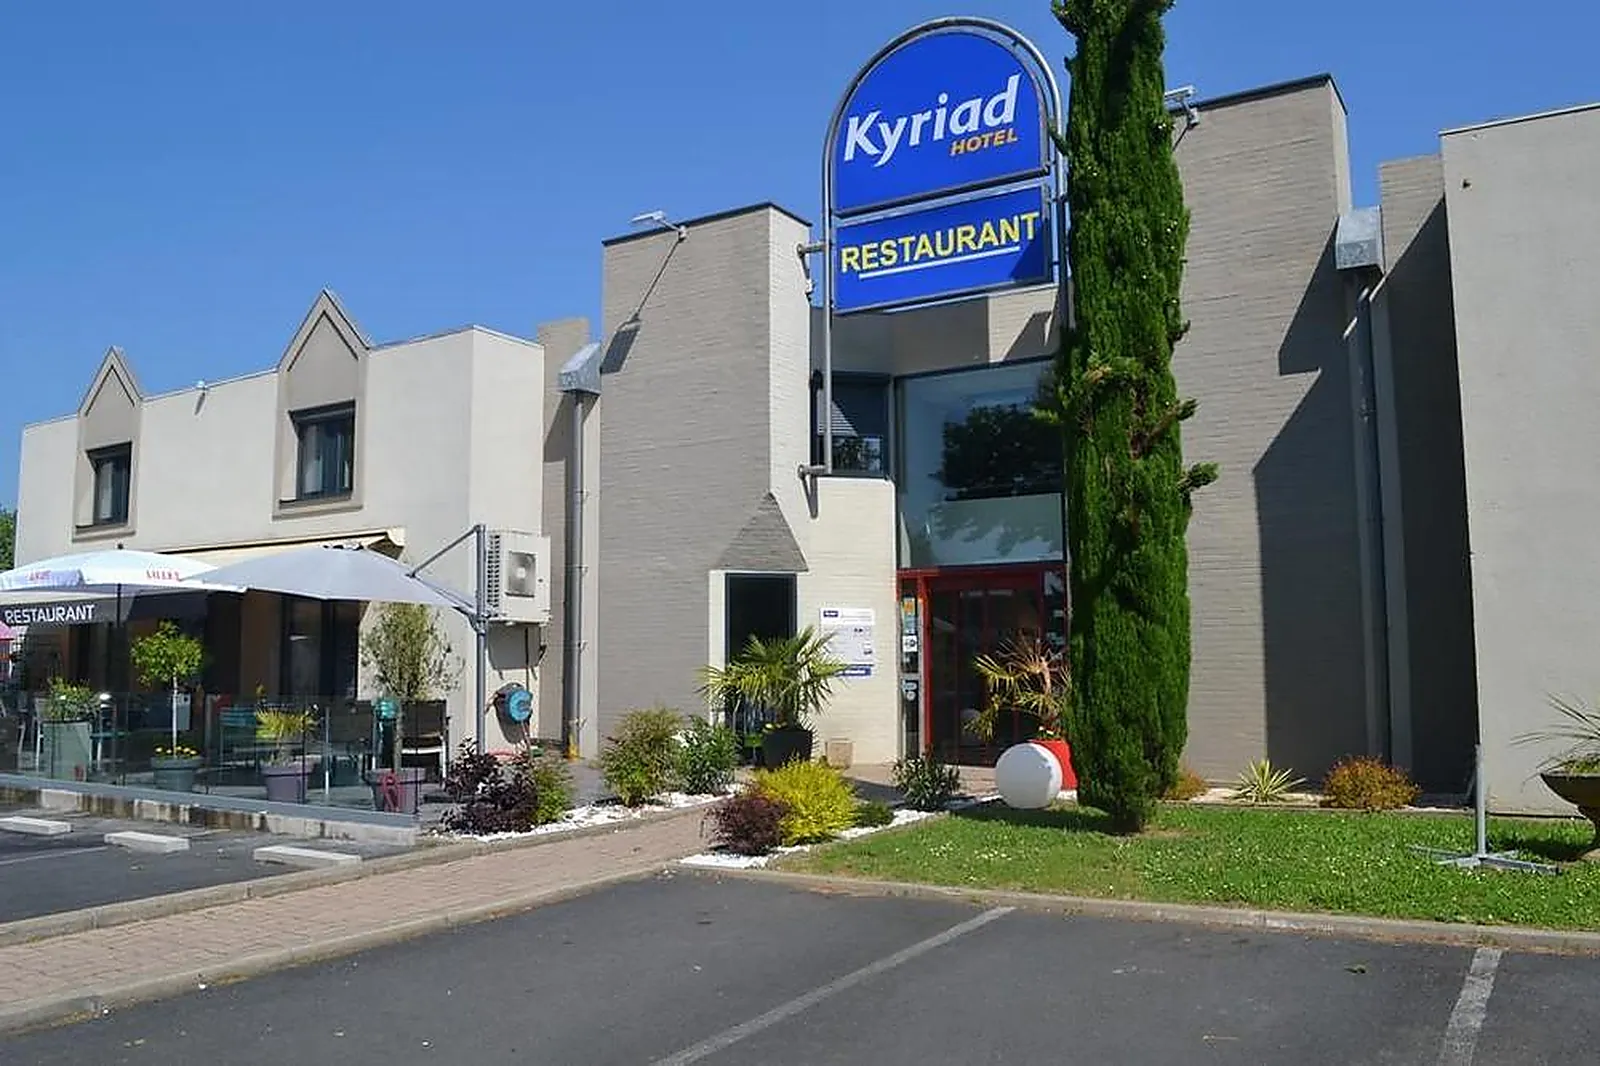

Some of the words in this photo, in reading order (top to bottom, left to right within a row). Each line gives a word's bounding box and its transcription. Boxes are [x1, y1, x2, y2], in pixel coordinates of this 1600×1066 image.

[843, 74, 1021, 167] Kyriad
[950, 128, 1018, 156] HOTEL
[841, 212, 1039, 273] RESTAURANT
[4, 604, 95, 624] RESTAURANT
